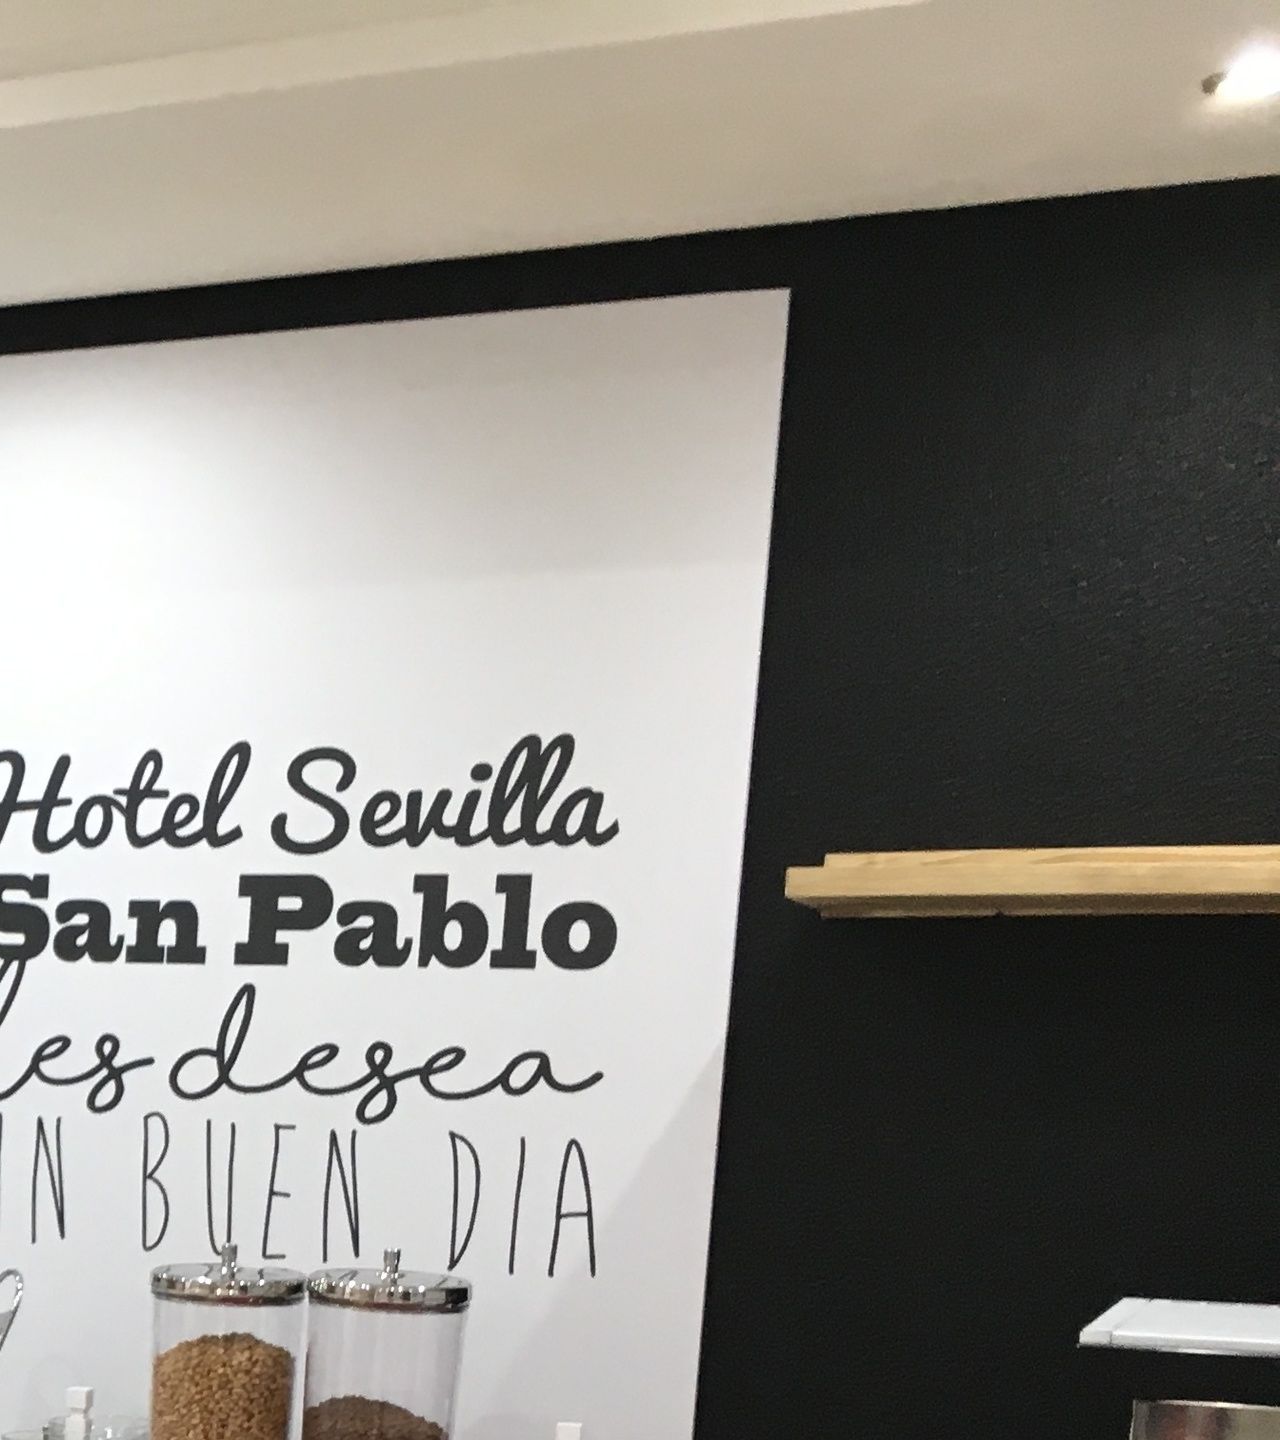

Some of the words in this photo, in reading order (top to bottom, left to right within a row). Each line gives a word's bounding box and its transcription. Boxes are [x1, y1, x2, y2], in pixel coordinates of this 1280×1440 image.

[271, 733, 620, 854] Sevilla
[234, 873, 618, 970] Pablo
[168, 983, 604, 1125] desea
[141, 1111, 359, 1264] BUEN
[448, 1130, 595, 1277] DIA
